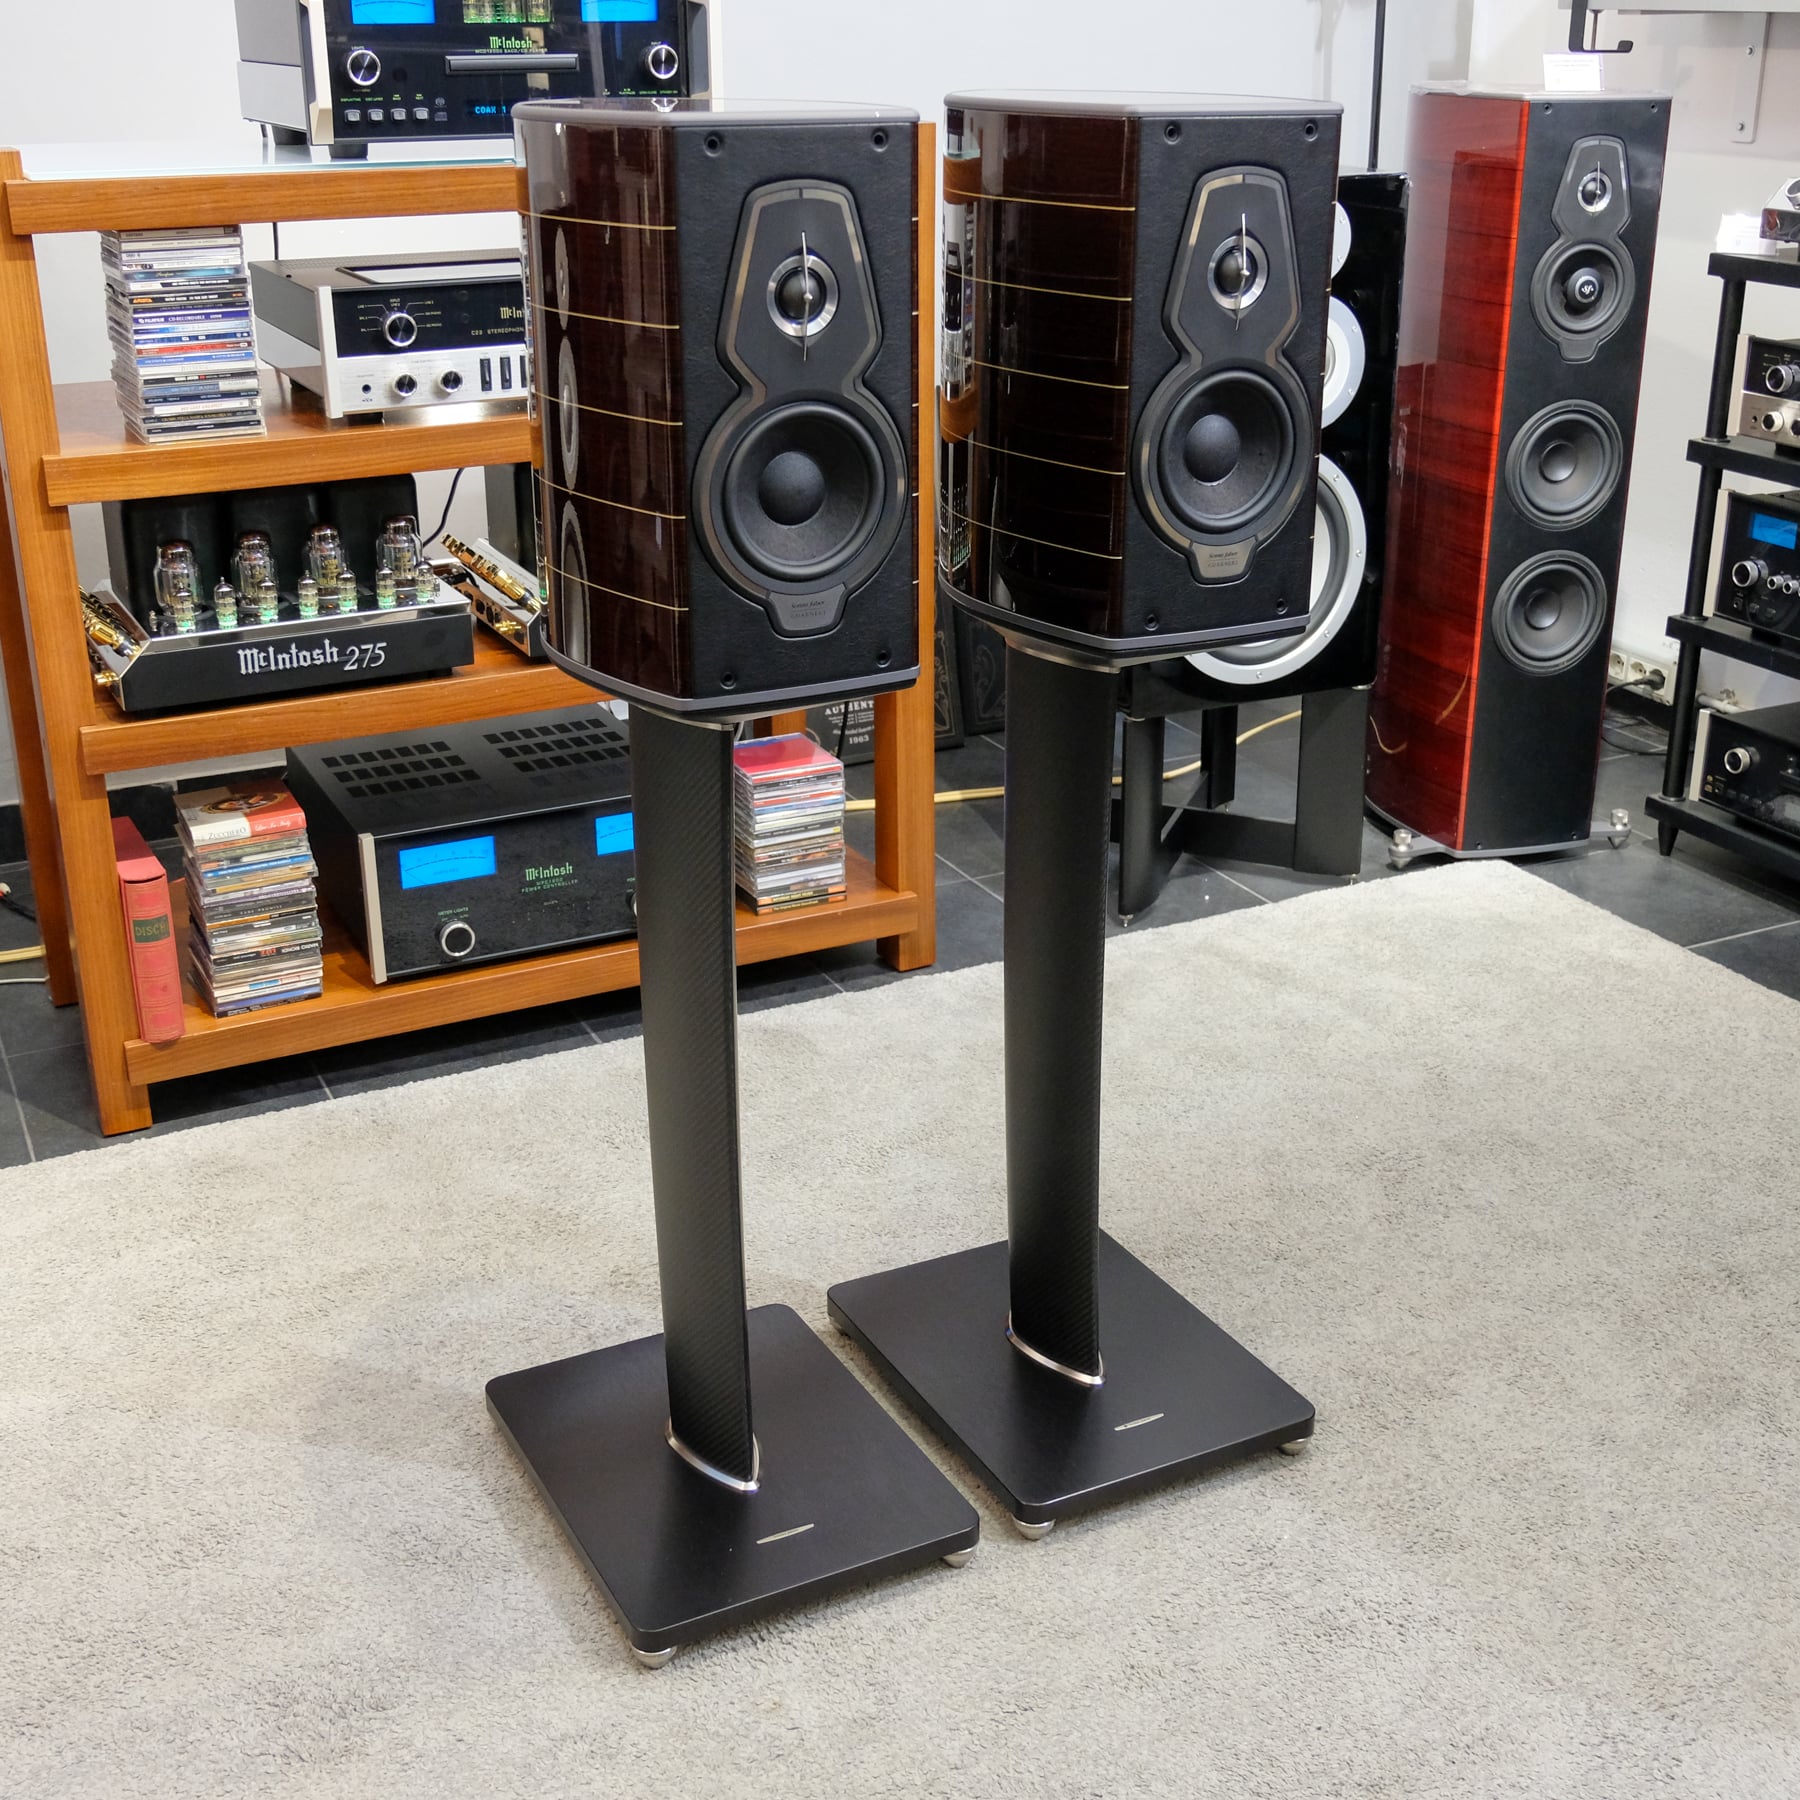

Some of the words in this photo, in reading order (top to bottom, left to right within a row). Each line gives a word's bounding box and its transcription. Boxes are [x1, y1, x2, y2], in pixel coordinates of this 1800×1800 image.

[489, 36, 533, 49] McIntosh
[474, 105, 497, 114] COAX
[500, 306, 524, 320] McIn
[237, 638, 339, 675] McIntosh
[343, 642, 387, 671] 275
[525, 861, 573, 881] McIntosh
